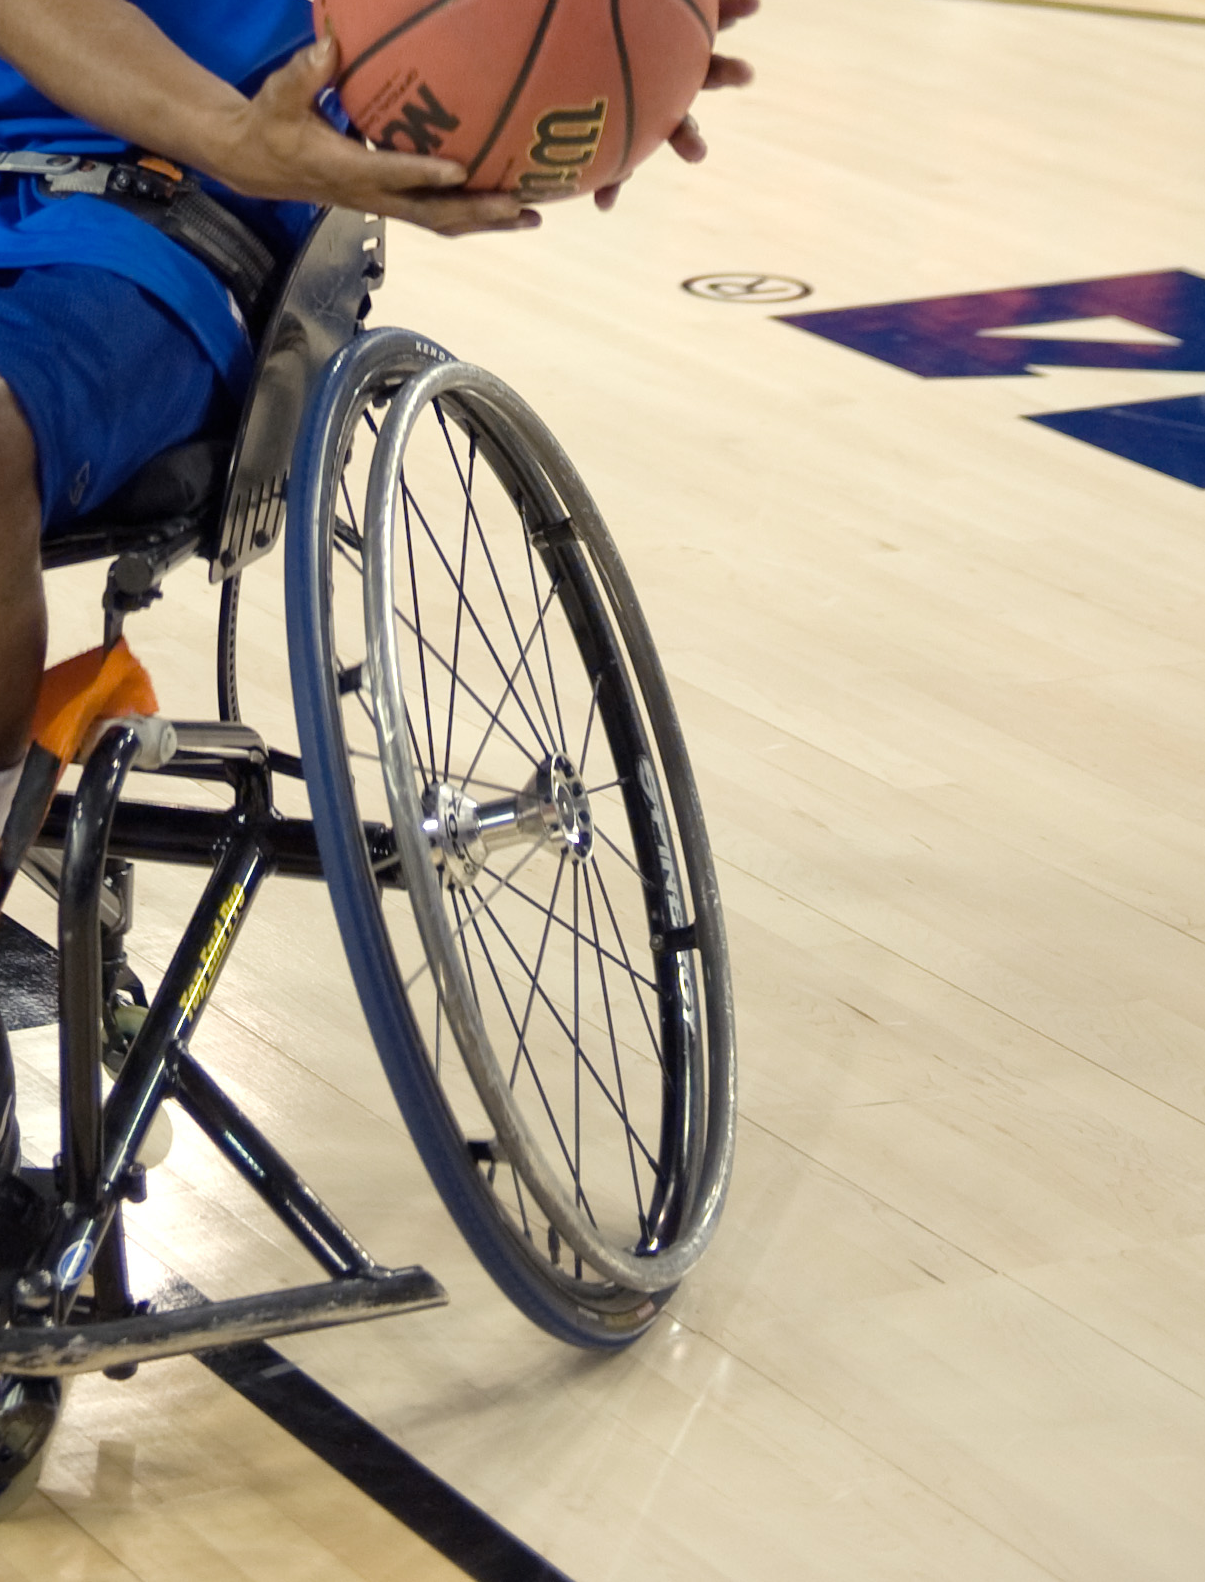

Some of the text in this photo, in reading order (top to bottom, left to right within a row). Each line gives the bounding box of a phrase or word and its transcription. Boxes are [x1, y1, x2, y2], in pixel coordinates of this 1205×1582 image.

[179, 881, 245, 1023] Top End Pro
